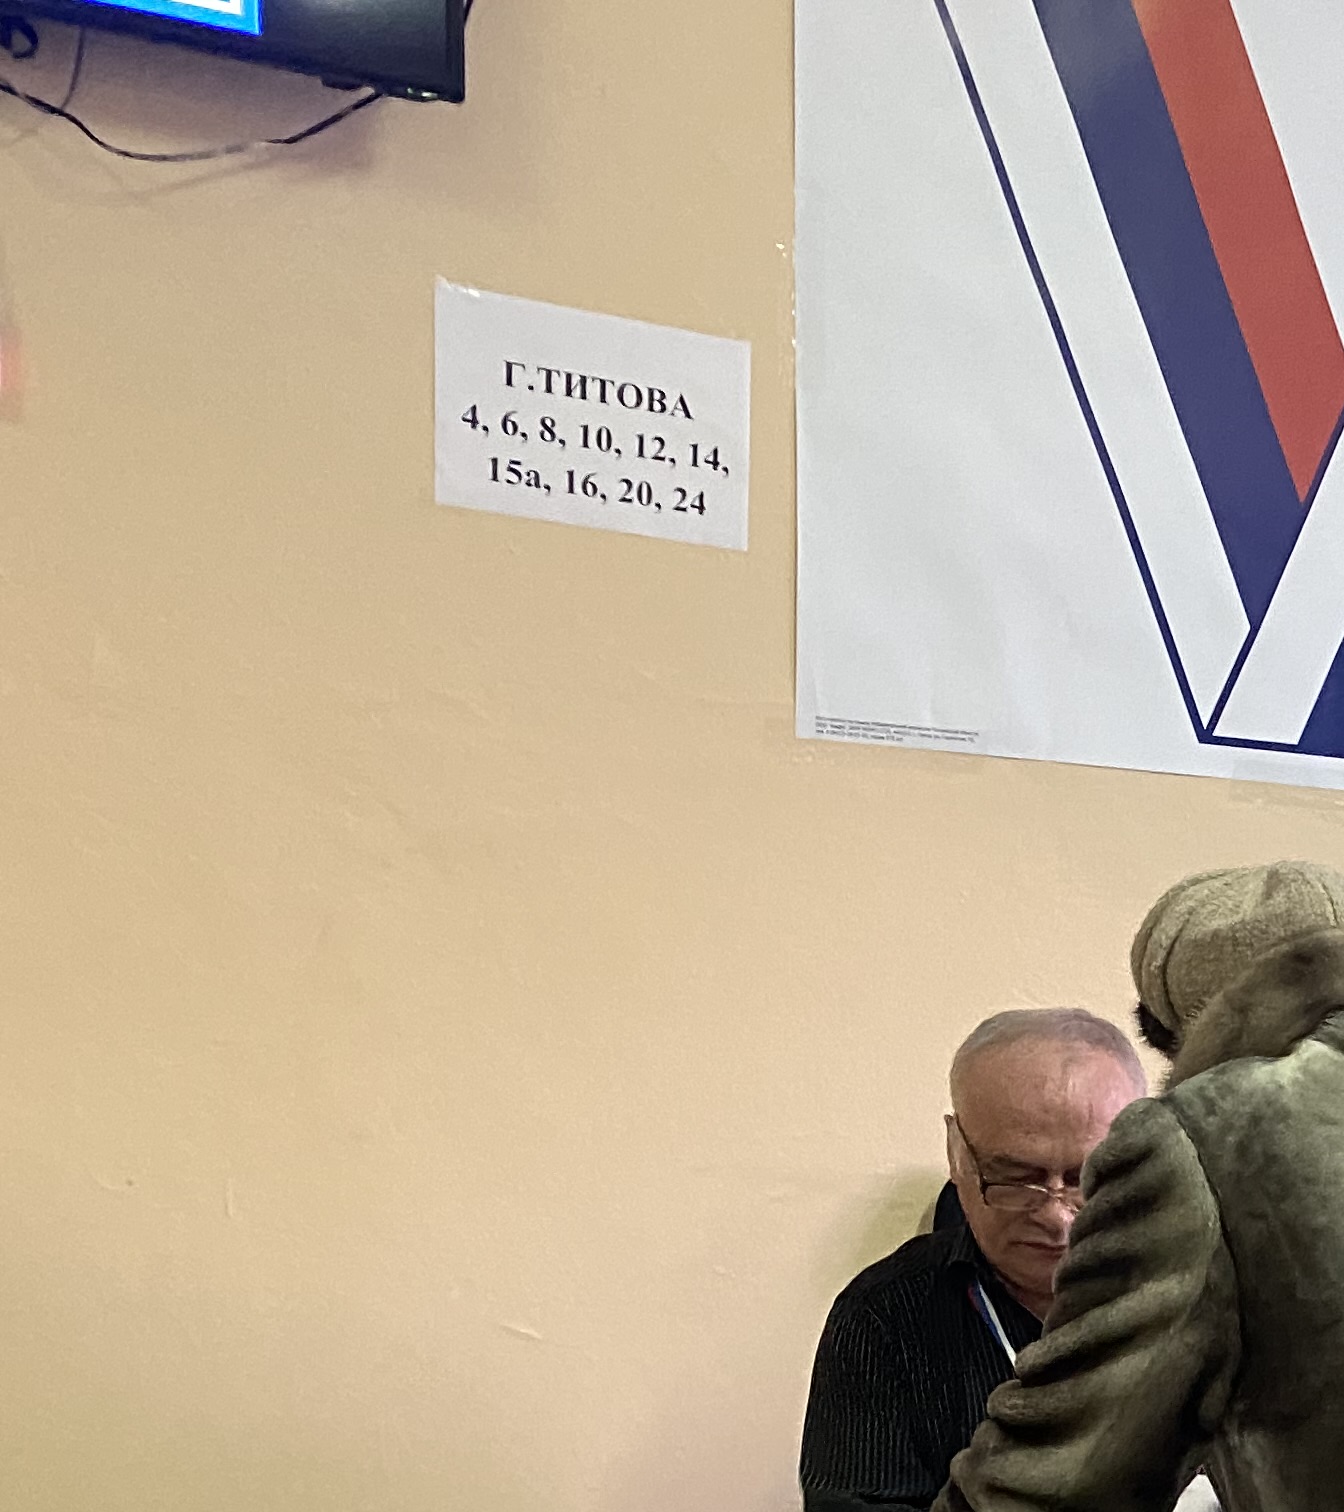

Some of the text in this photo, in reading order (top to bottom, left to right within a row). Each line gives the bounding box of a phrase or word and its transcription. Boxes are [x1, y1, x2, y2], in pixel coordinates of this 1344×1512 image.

[502, 359, 695, 421] Г.ТИТОВА
[460, 403, 730, 477] 4, 6, 8, 10, 12, 14,
[488, 456, 707, 517] 15а, 16, 20, 24
